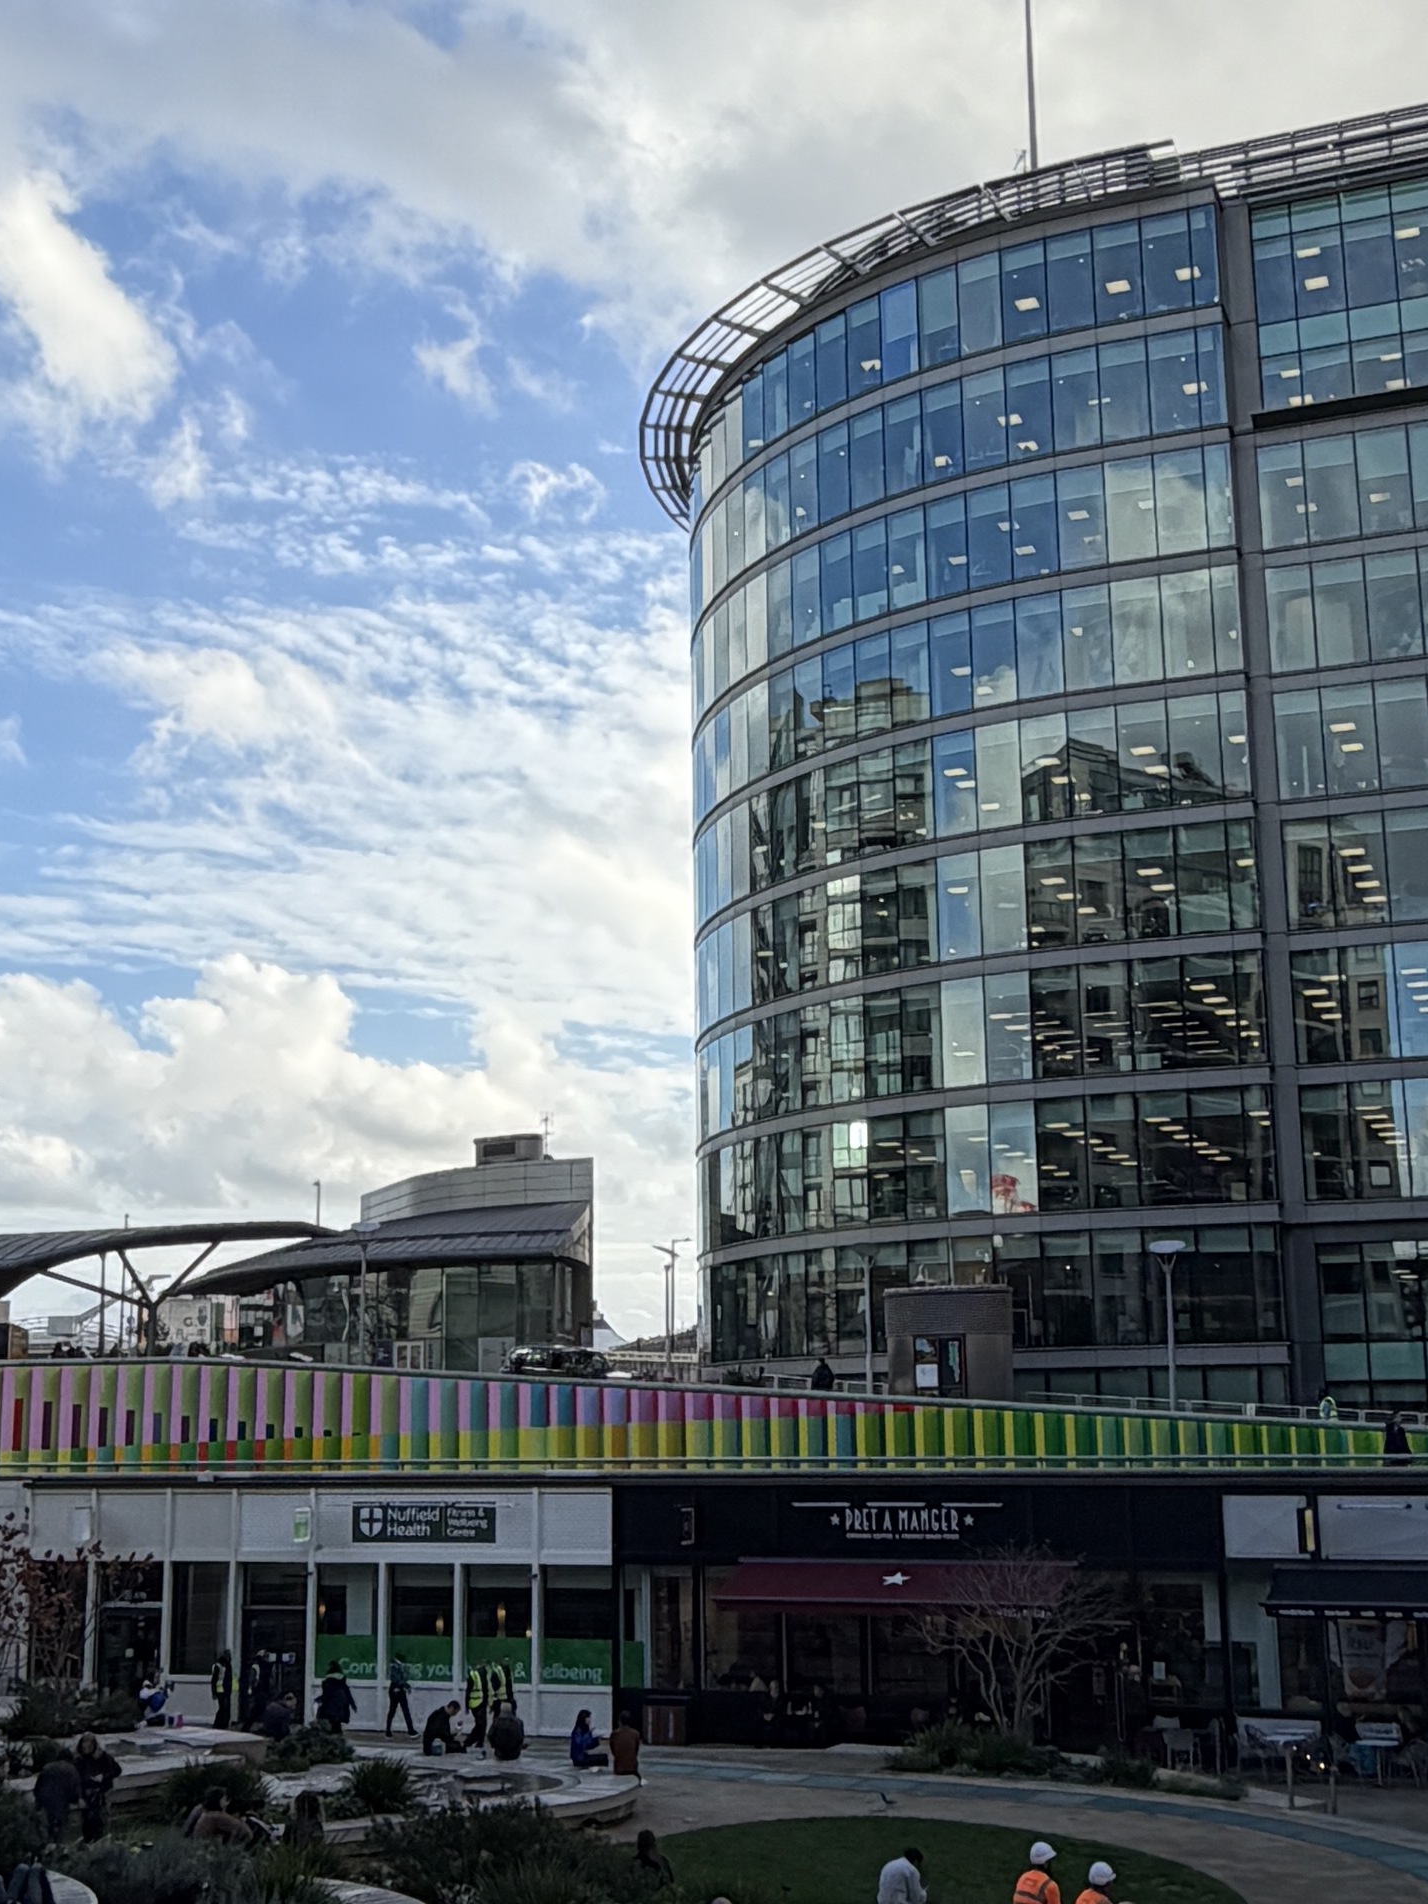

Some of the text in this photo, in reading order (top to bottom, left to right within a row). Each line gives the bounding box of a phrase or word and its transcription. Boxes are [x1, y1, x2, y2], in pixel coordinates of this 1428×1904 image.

[387, 1507, 440, 1522] Nuffield
[845, 1508, 959, 1532] PRET A MANGER
[387, 1523, 430, 1537] Health
